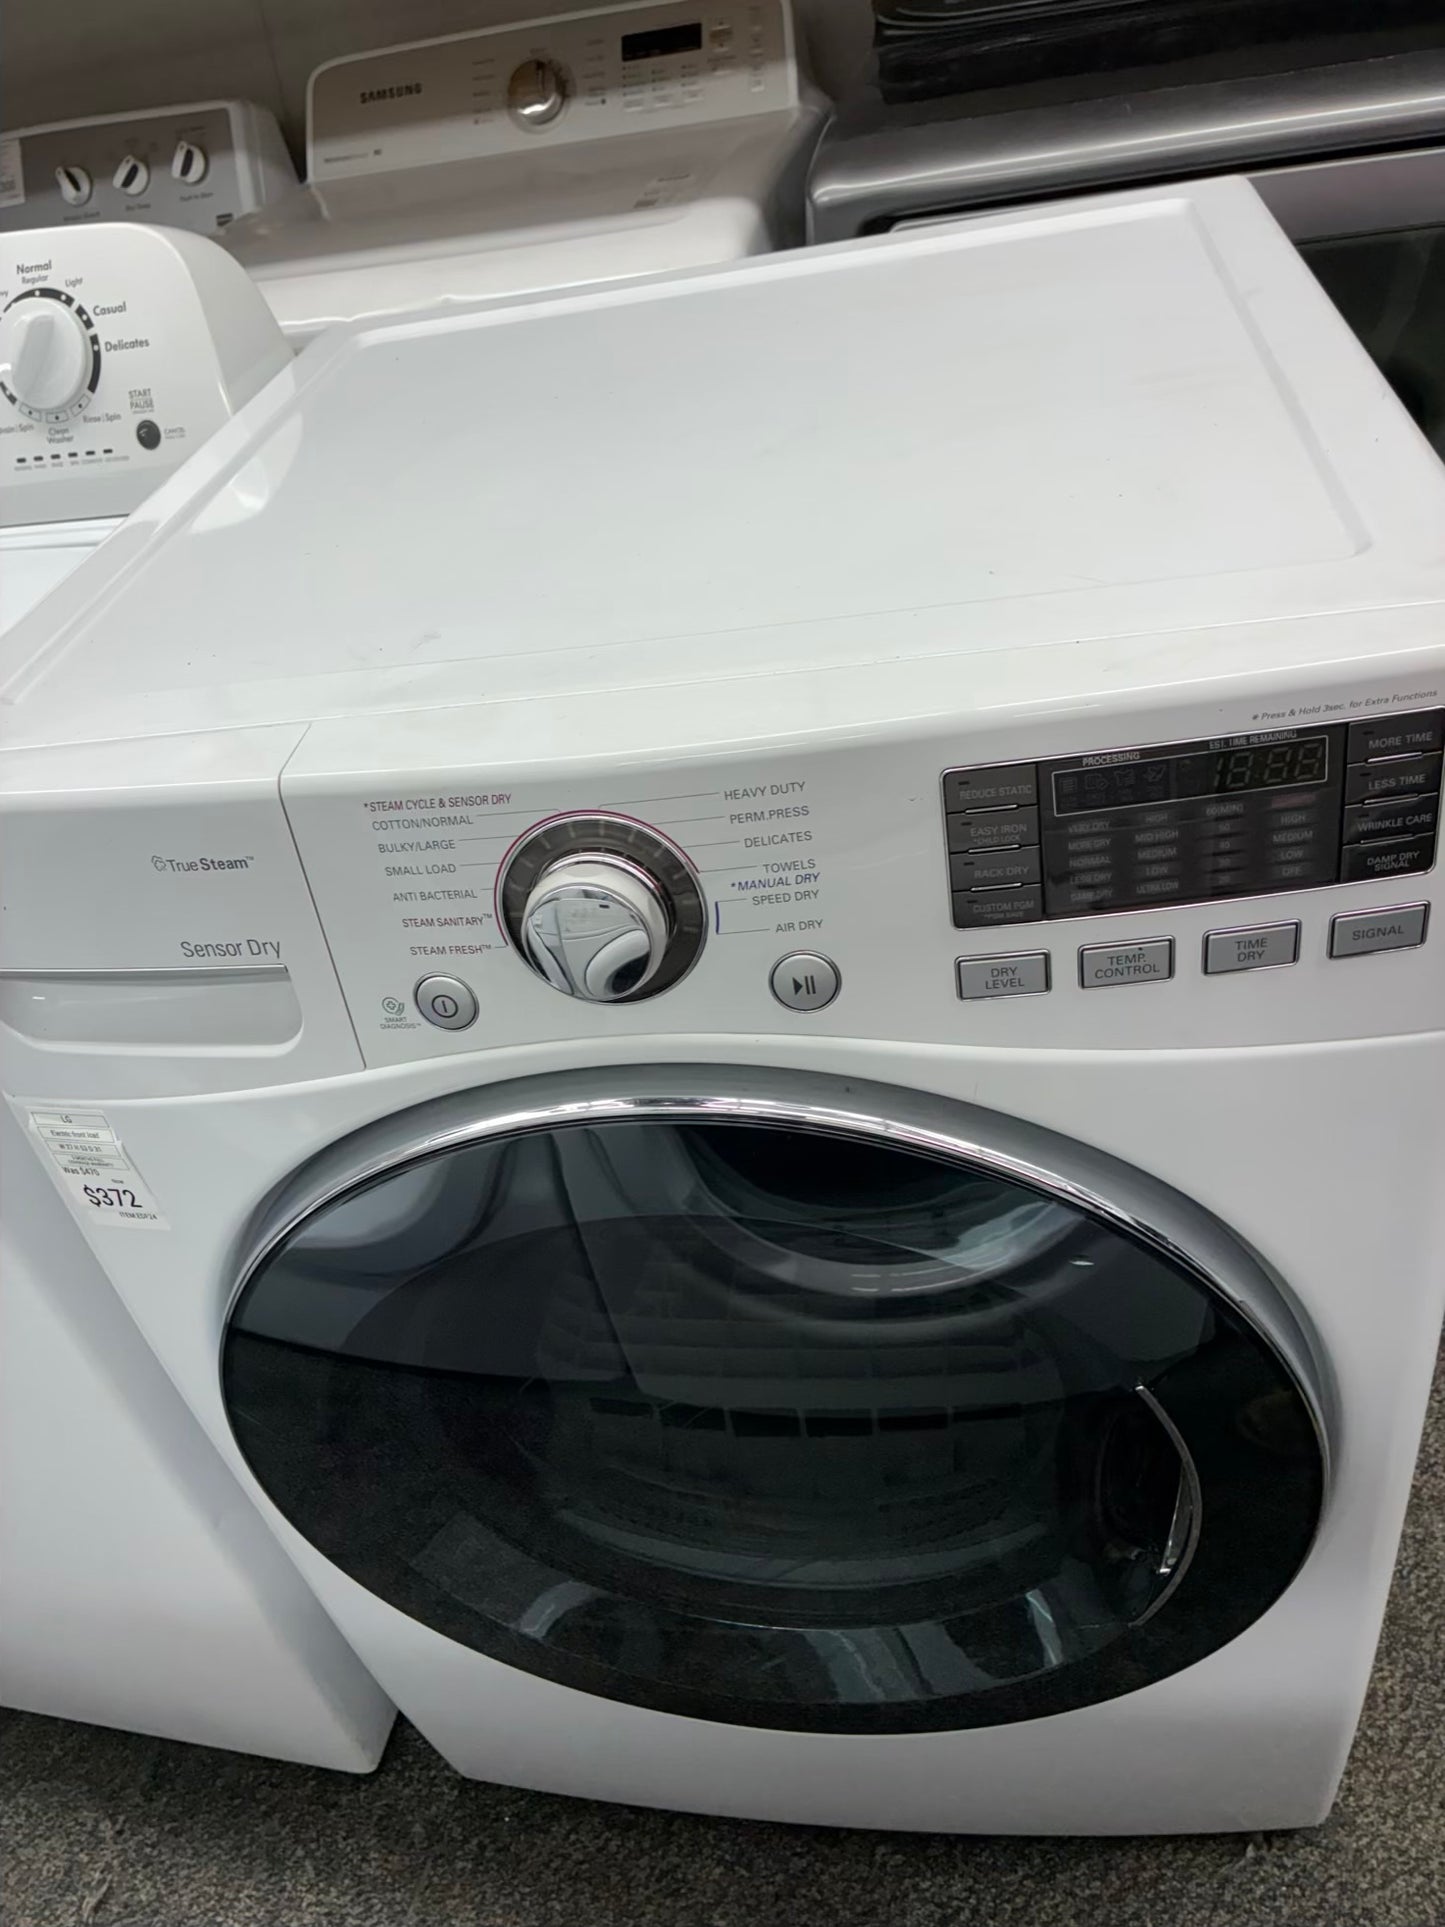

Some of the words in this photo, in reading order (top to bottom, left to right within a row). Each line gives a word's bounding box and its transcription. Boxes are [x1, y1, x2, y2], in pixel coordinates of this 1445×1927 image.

[360, 83, 422, 104] SAMSUNG
[16, 260, 52, 274] Normal
[22, 274, 48, 285] Regular
[65, 278, 82, 288] Light
[93, 302, 126, 316] Casual
[105, 338, 149, 352] Delicates
[128, 388, 151, 398] START
[130, 398, 154, 409] PAUSE
[1261, 712, 1285, 720] Press
[1288, 709, 1296, 717] &
[1298, 706, 1320, 715] Hold
[1350, 700, 1362, 709] for
[1364, 697, 1389, 707] Extra
[1391, 690, 1438, 702] Functions
[1249, 730, 1297, 744] REMAINING
[1368, 735, 1402, 749] MORE
[1405, 732, 1433, 743] TIME
[1082, 752, 1141, 766] PROCESSING
[1368, 780, 1396, 790] LESS
[1399, 774, 1426, 785] TIME
[724, 786, 767, 801] HEAVY
[770, 781, 806, 796] DUTY
[960, 788, 998, 800] REDUCE
[1000, 785, 1032, 796] STATIC
[405, 799, 435, 810] CYCLE
[438, 798, 446, 808] &
[448, 795, 489, 808] SENSOR
[491, 793, 512, 805] DRY
[372, 815, 473, 831] COTTON/NORMAL
[1357, 817, 1403, 832] WRINKLE
[1405, 813, 1433, 825] CARE
[970, 826, 998, 837] EASY
[1001, 824, 1027, 834] IRON
[743, 830, 813, 848] DELICATES
[378, 839, 456, 854] BULKY/LARGE
[1399, 851, 1420, 861] DRY
[385, 865, 423, 877] SMALL
[425, 863, 456, 874] LOAD
[763, 858, 816, 874] TOWELS
[1006, 866, 1029, 876] DRY
[795, 872, 820, 885] DRY
[393, 892, 418, 902] ANTI
[420, 889, 478, 901] BACTERIAL
[752, 892, 792, 906] SPEED
[795, 889, 820, 902] DRY
[402, 918, 435, 928] STEAM
[775, 922, 795, 933] AIR
[799, 919, 823, 931] DRY
[1352, 924, 1404, 941] SIGNAL
[180, 941, 242, 958] Sensor
[247, 939, 280, 959] Dry
[1235, 937, 1268, 950] TIME
[410, 946, 447, 956] STEAM
[1237, 950, 1265, 962] DRY
[1108, 953, 1146, 966] TEMP.
[990, 966, 1018, 978] DRY
[1095, 964, 1160, 980] CONTROL
[985, 978, 1024, 990] LEVEL
[60, 1114, 72, 1124] LG
[61, 1166, 80, 1175] Was
[83, 1184, 143, 1208] $372
